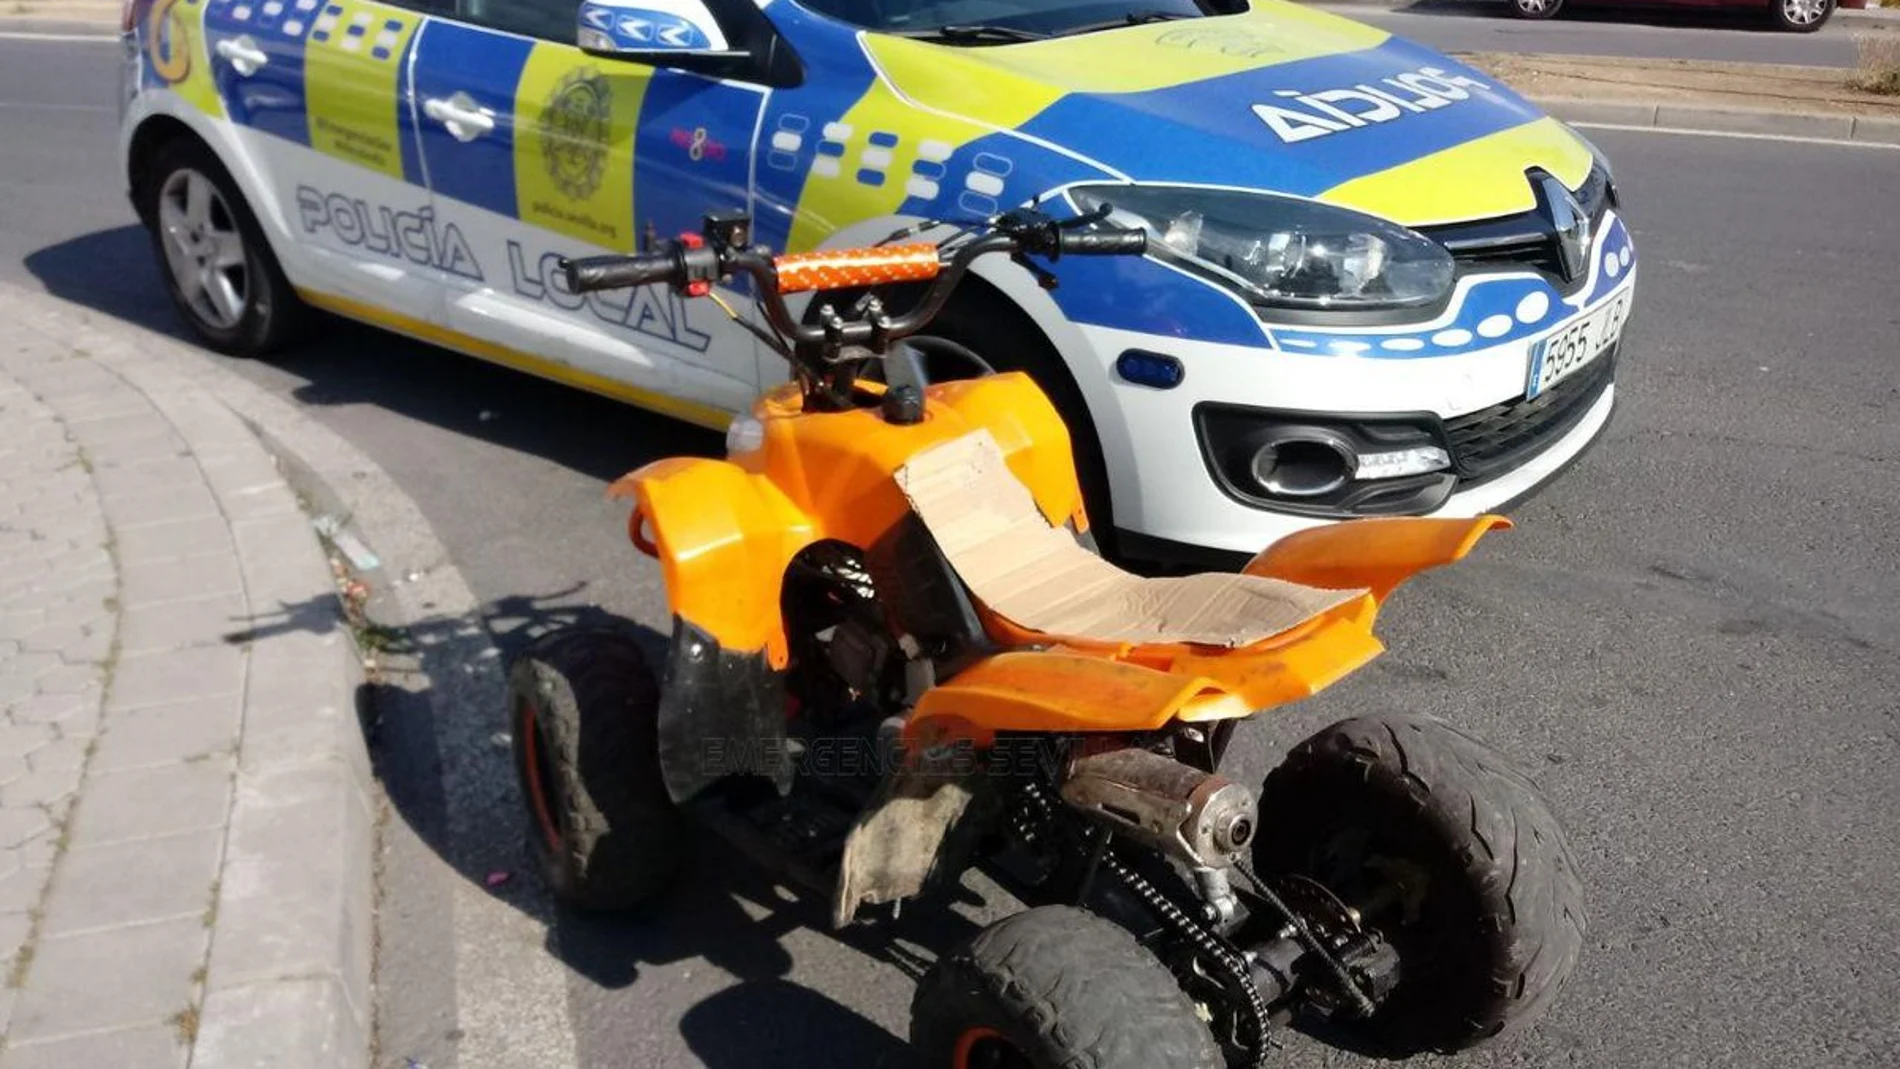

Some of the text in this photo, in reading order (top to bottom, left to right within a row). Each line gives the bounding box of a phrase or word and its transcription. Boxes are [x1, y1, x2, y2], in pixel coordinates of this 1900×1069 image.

[297, 185, 711, 352] POLICÍA LOCAL
[1545, 321, 1590, 381] 5955
